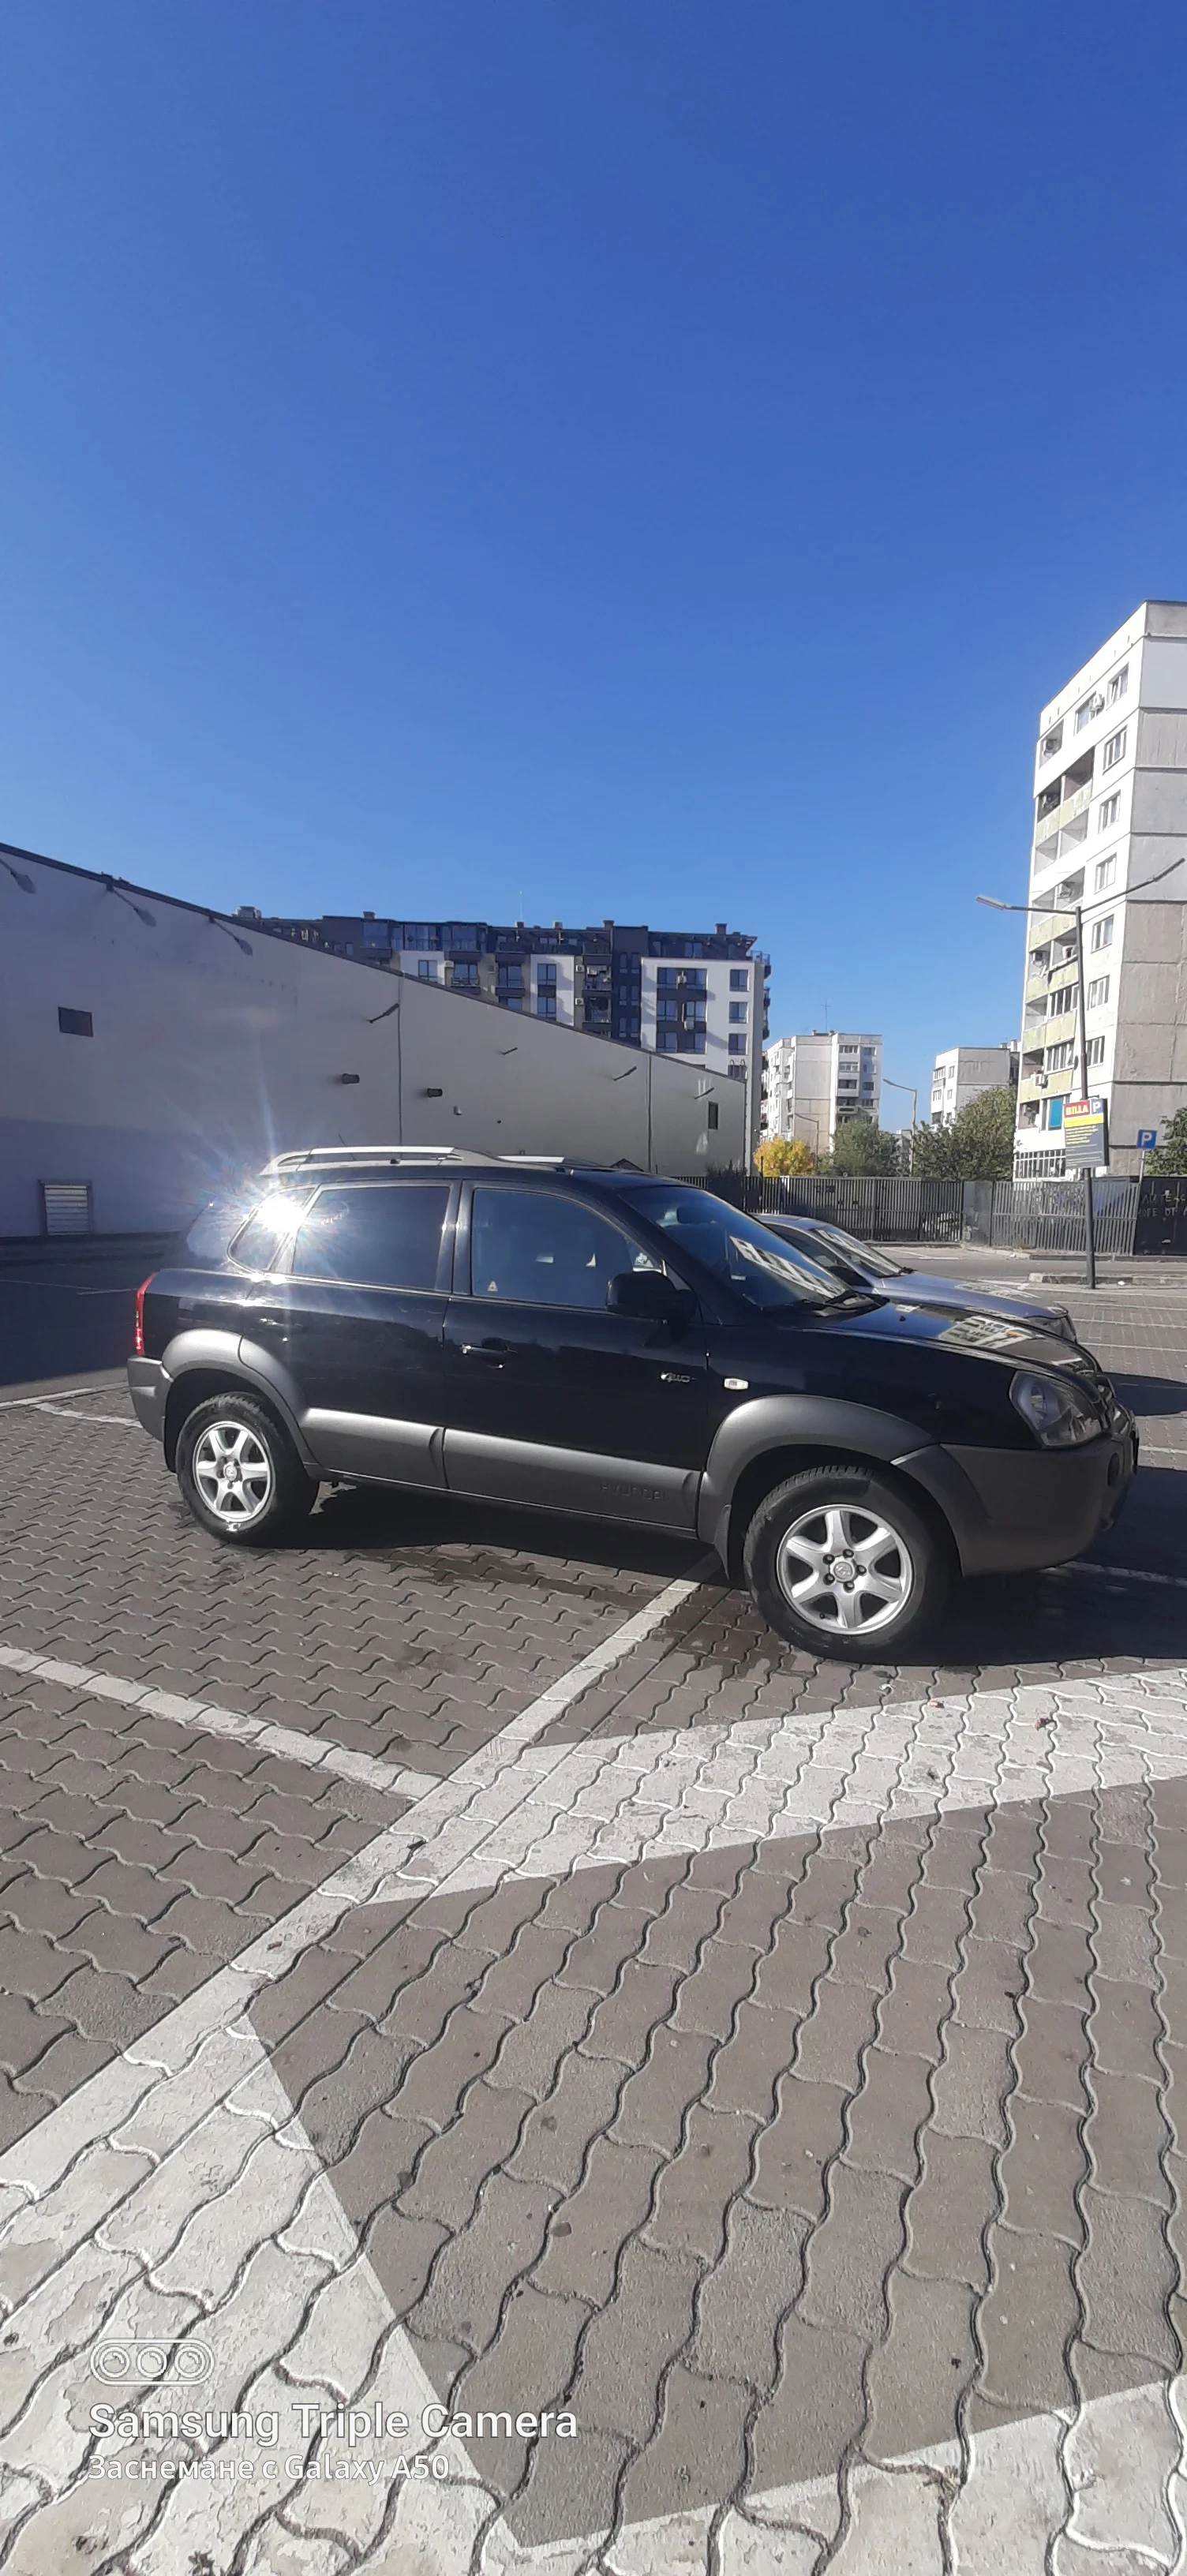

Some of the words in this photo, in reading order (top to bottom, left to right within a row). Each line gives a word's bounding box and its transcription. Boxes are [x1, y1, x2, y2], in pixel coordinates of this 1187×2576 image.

[1065, 1105, 1088, 1116] BILLA
[1093, 1102, 1101, 1113] P
[1140, 1132, 1152, 1147] P
